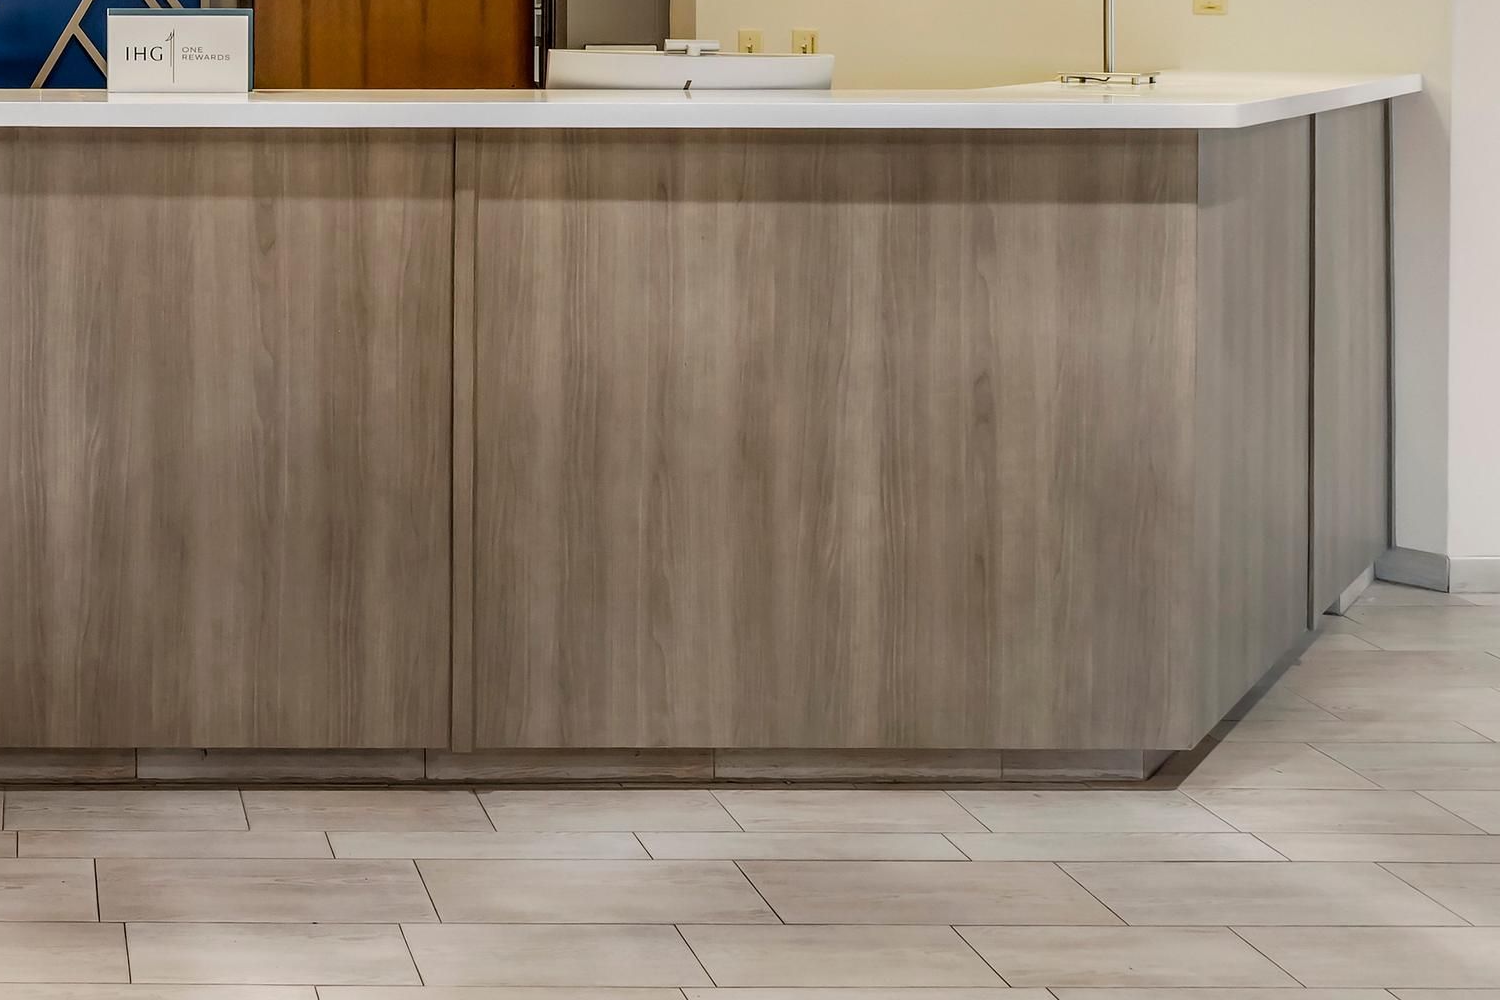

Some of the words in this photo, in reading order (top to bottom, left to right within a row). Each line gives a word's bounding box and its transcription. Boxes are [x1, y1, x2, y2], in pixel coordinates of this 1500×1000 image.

[125, 46, 163, 61] IHG
[181, 46, 204, 54] ONE
[181, 54, 231, 62] REWARDS
